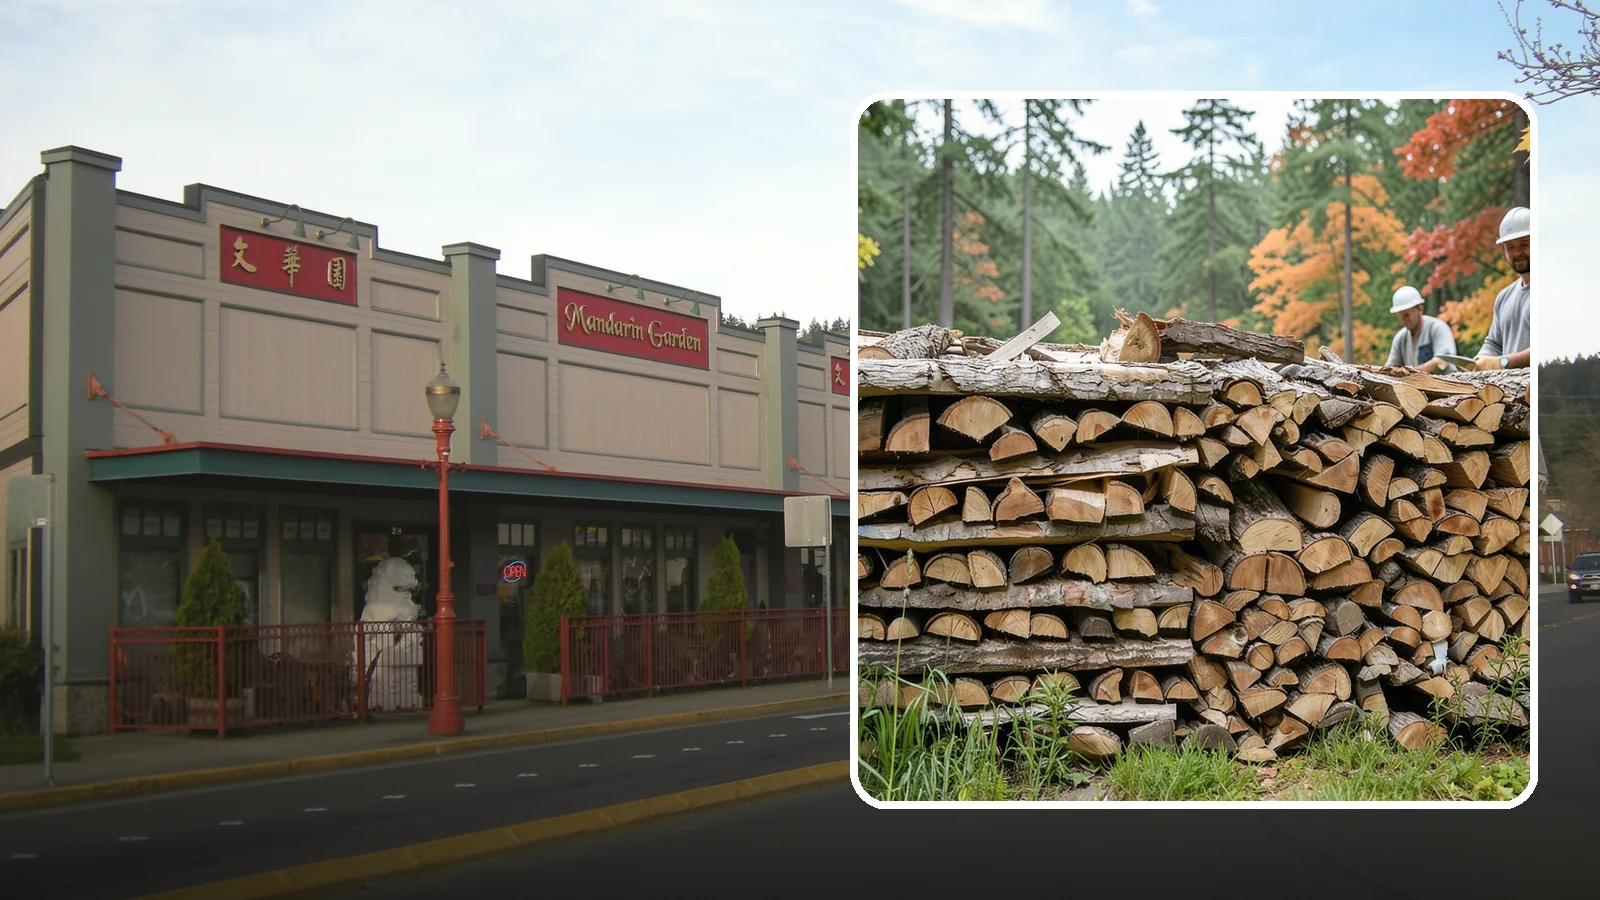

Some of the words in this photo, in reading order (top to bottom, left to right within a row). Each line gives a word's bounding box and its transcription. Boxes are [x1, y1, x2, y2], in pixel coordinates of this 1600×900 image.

[230, 235, 347, 291] 文華園
[564, 302, 644, 341] Mandarin
[648, 320, 702, 352] Garden
[503, 565, 527, 578] OPEN
